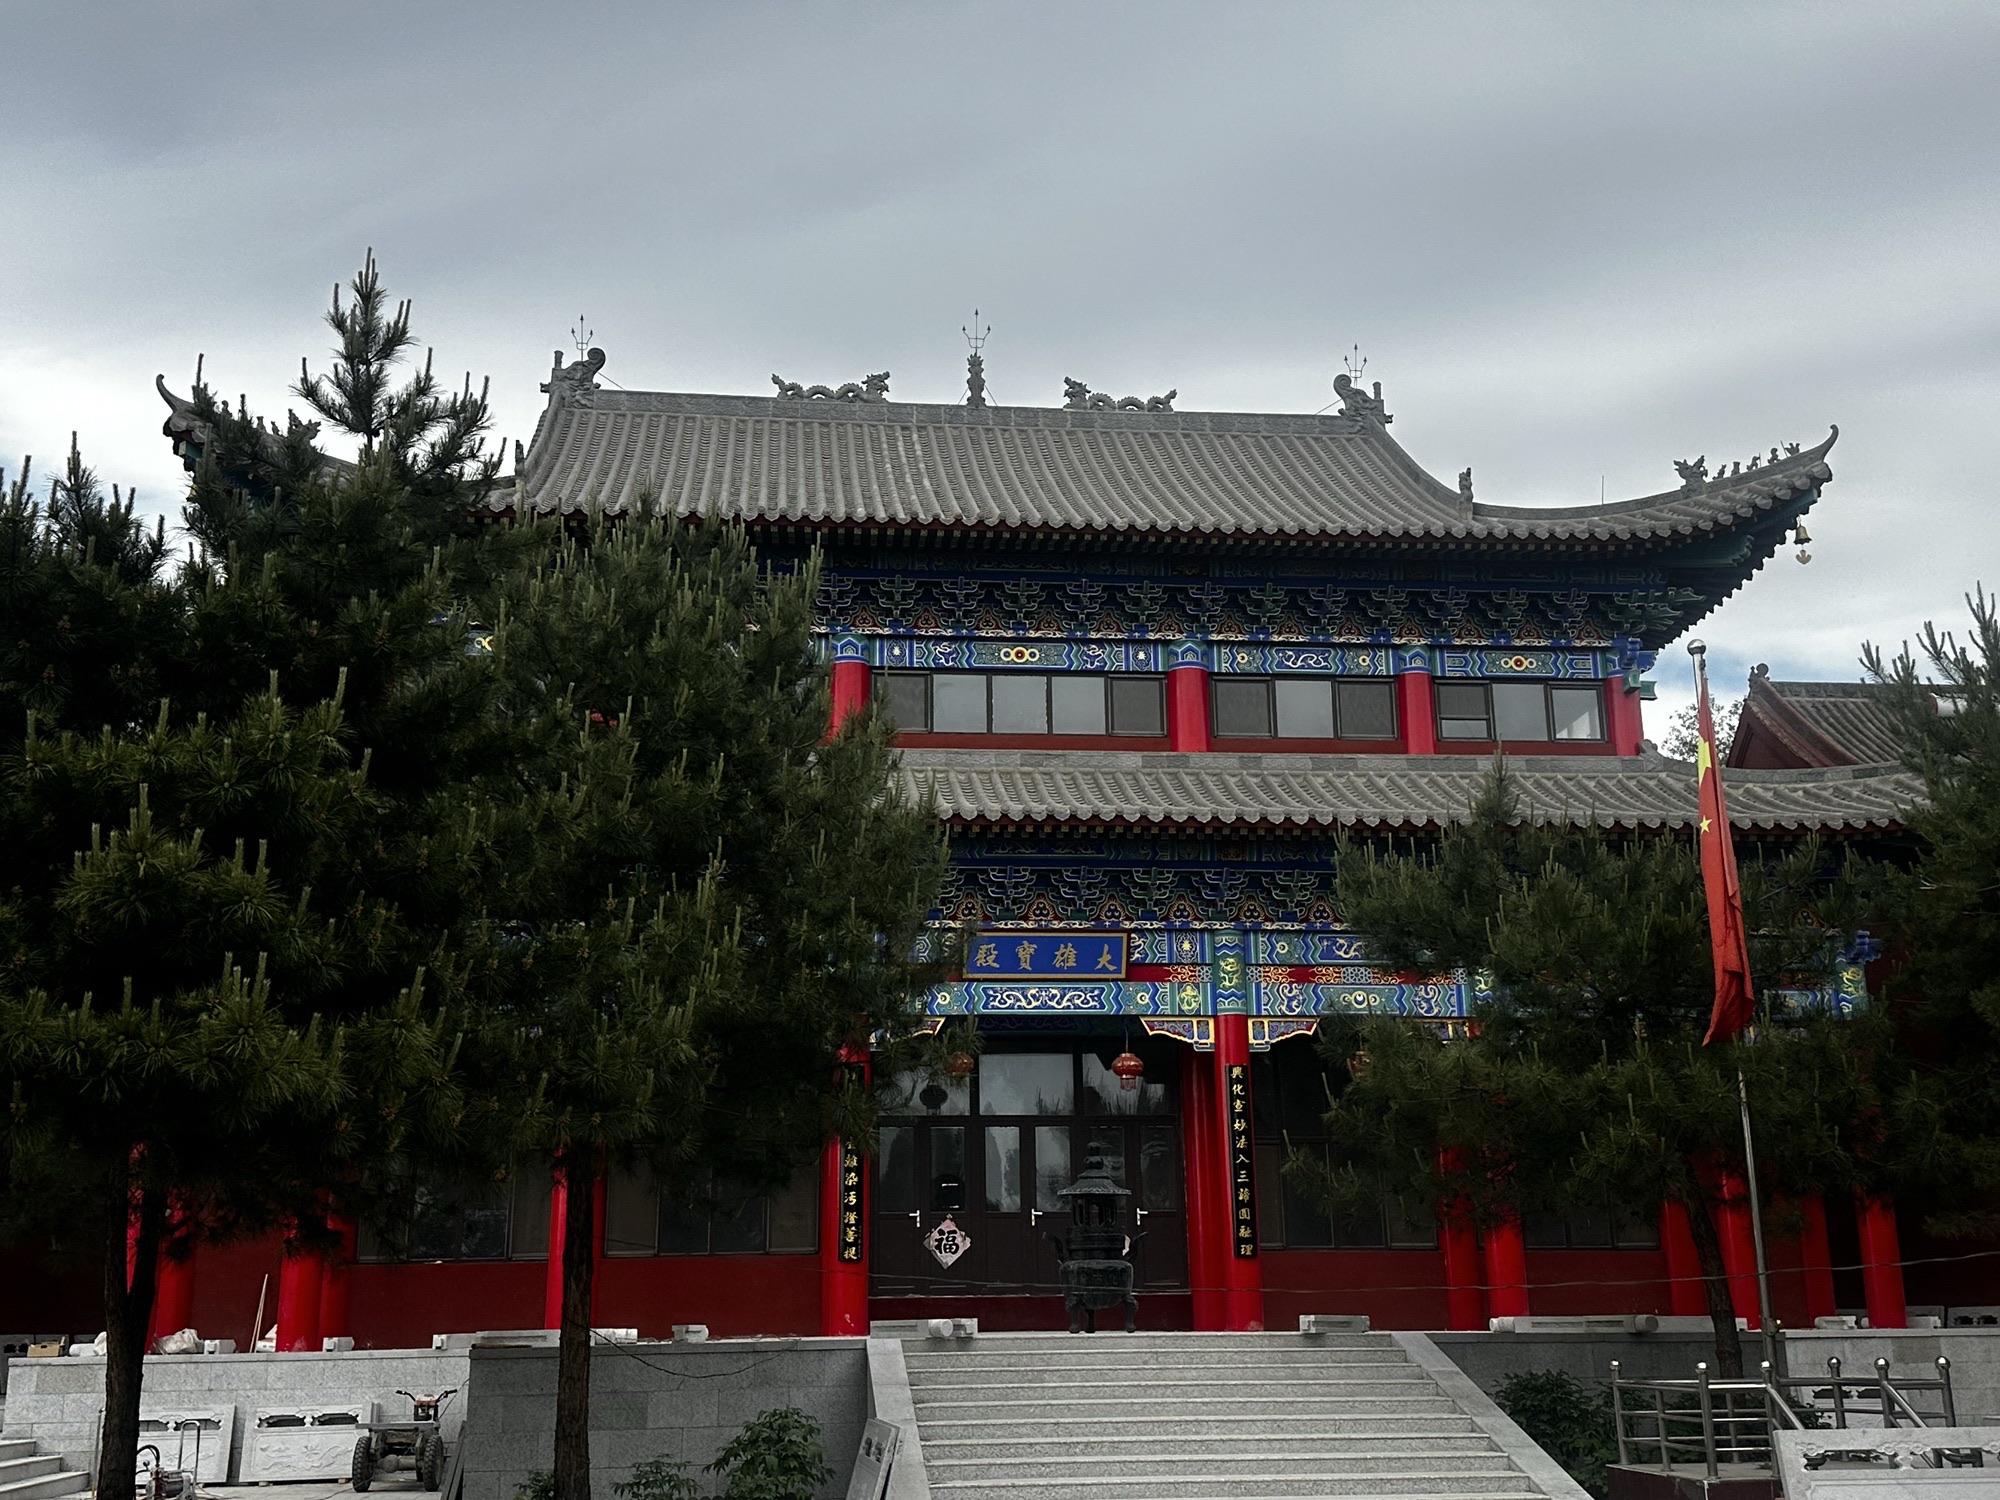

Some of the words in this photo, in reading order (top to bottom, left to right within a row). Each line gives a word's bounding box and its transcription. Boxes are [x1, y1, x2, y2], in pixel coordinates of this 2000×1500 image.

[973, 940, 1117, 971] 大雄寶殿
[934, 1228, 960, 1255] 福
